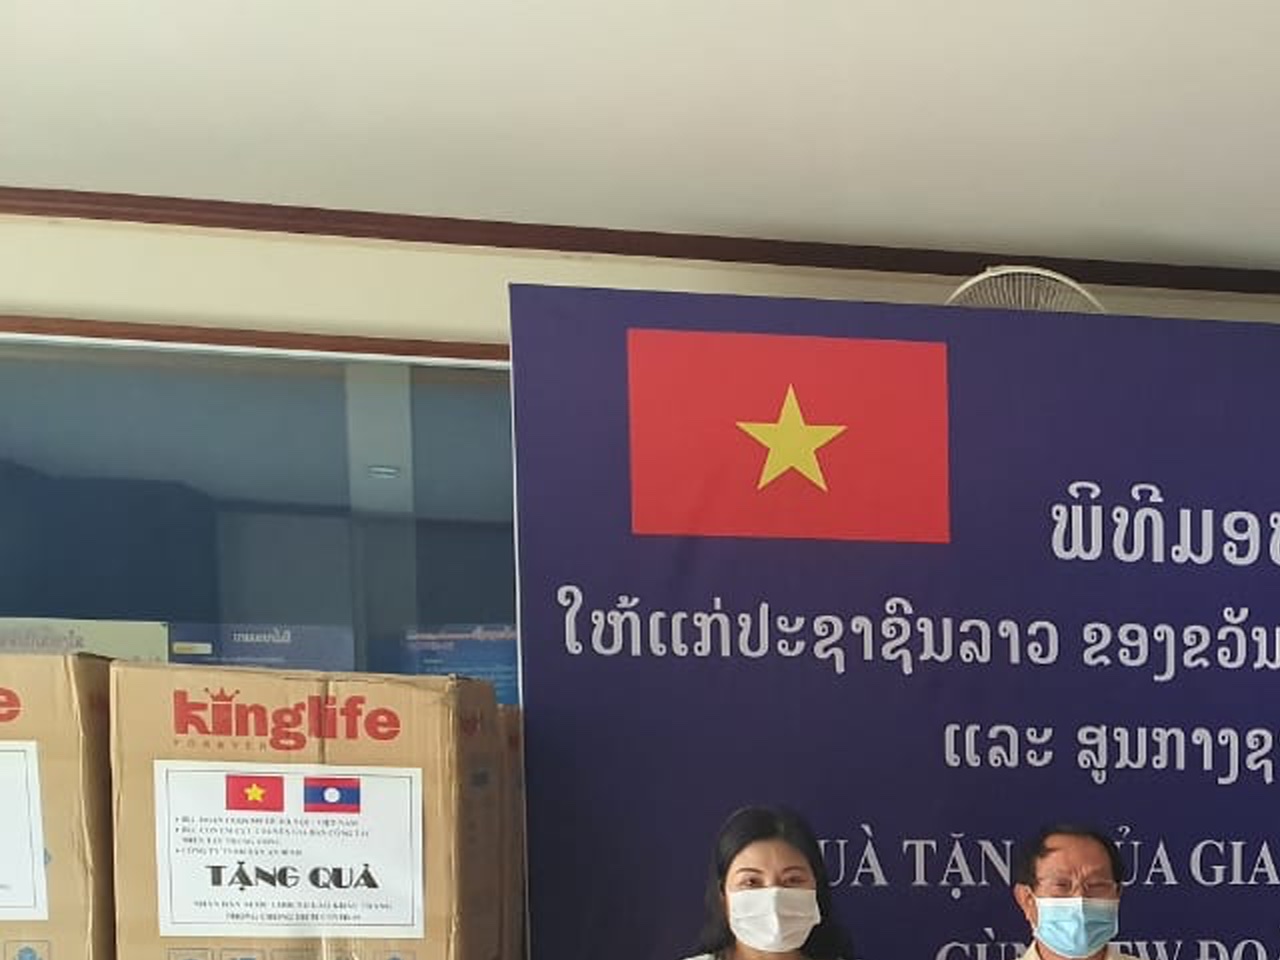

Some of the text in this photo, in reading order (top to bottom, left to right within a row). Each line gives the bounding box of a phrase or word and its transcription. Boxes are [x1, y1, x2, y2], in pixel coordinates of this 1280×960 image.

[173, 688, 401, 751] kinglife
[205, 861, 300, 891] TẶNG
[817, 823, 890, 887] UÀ
[902, 832, 1015, 900] TẶN
[1113, 825, 1179, 886] ỦA
